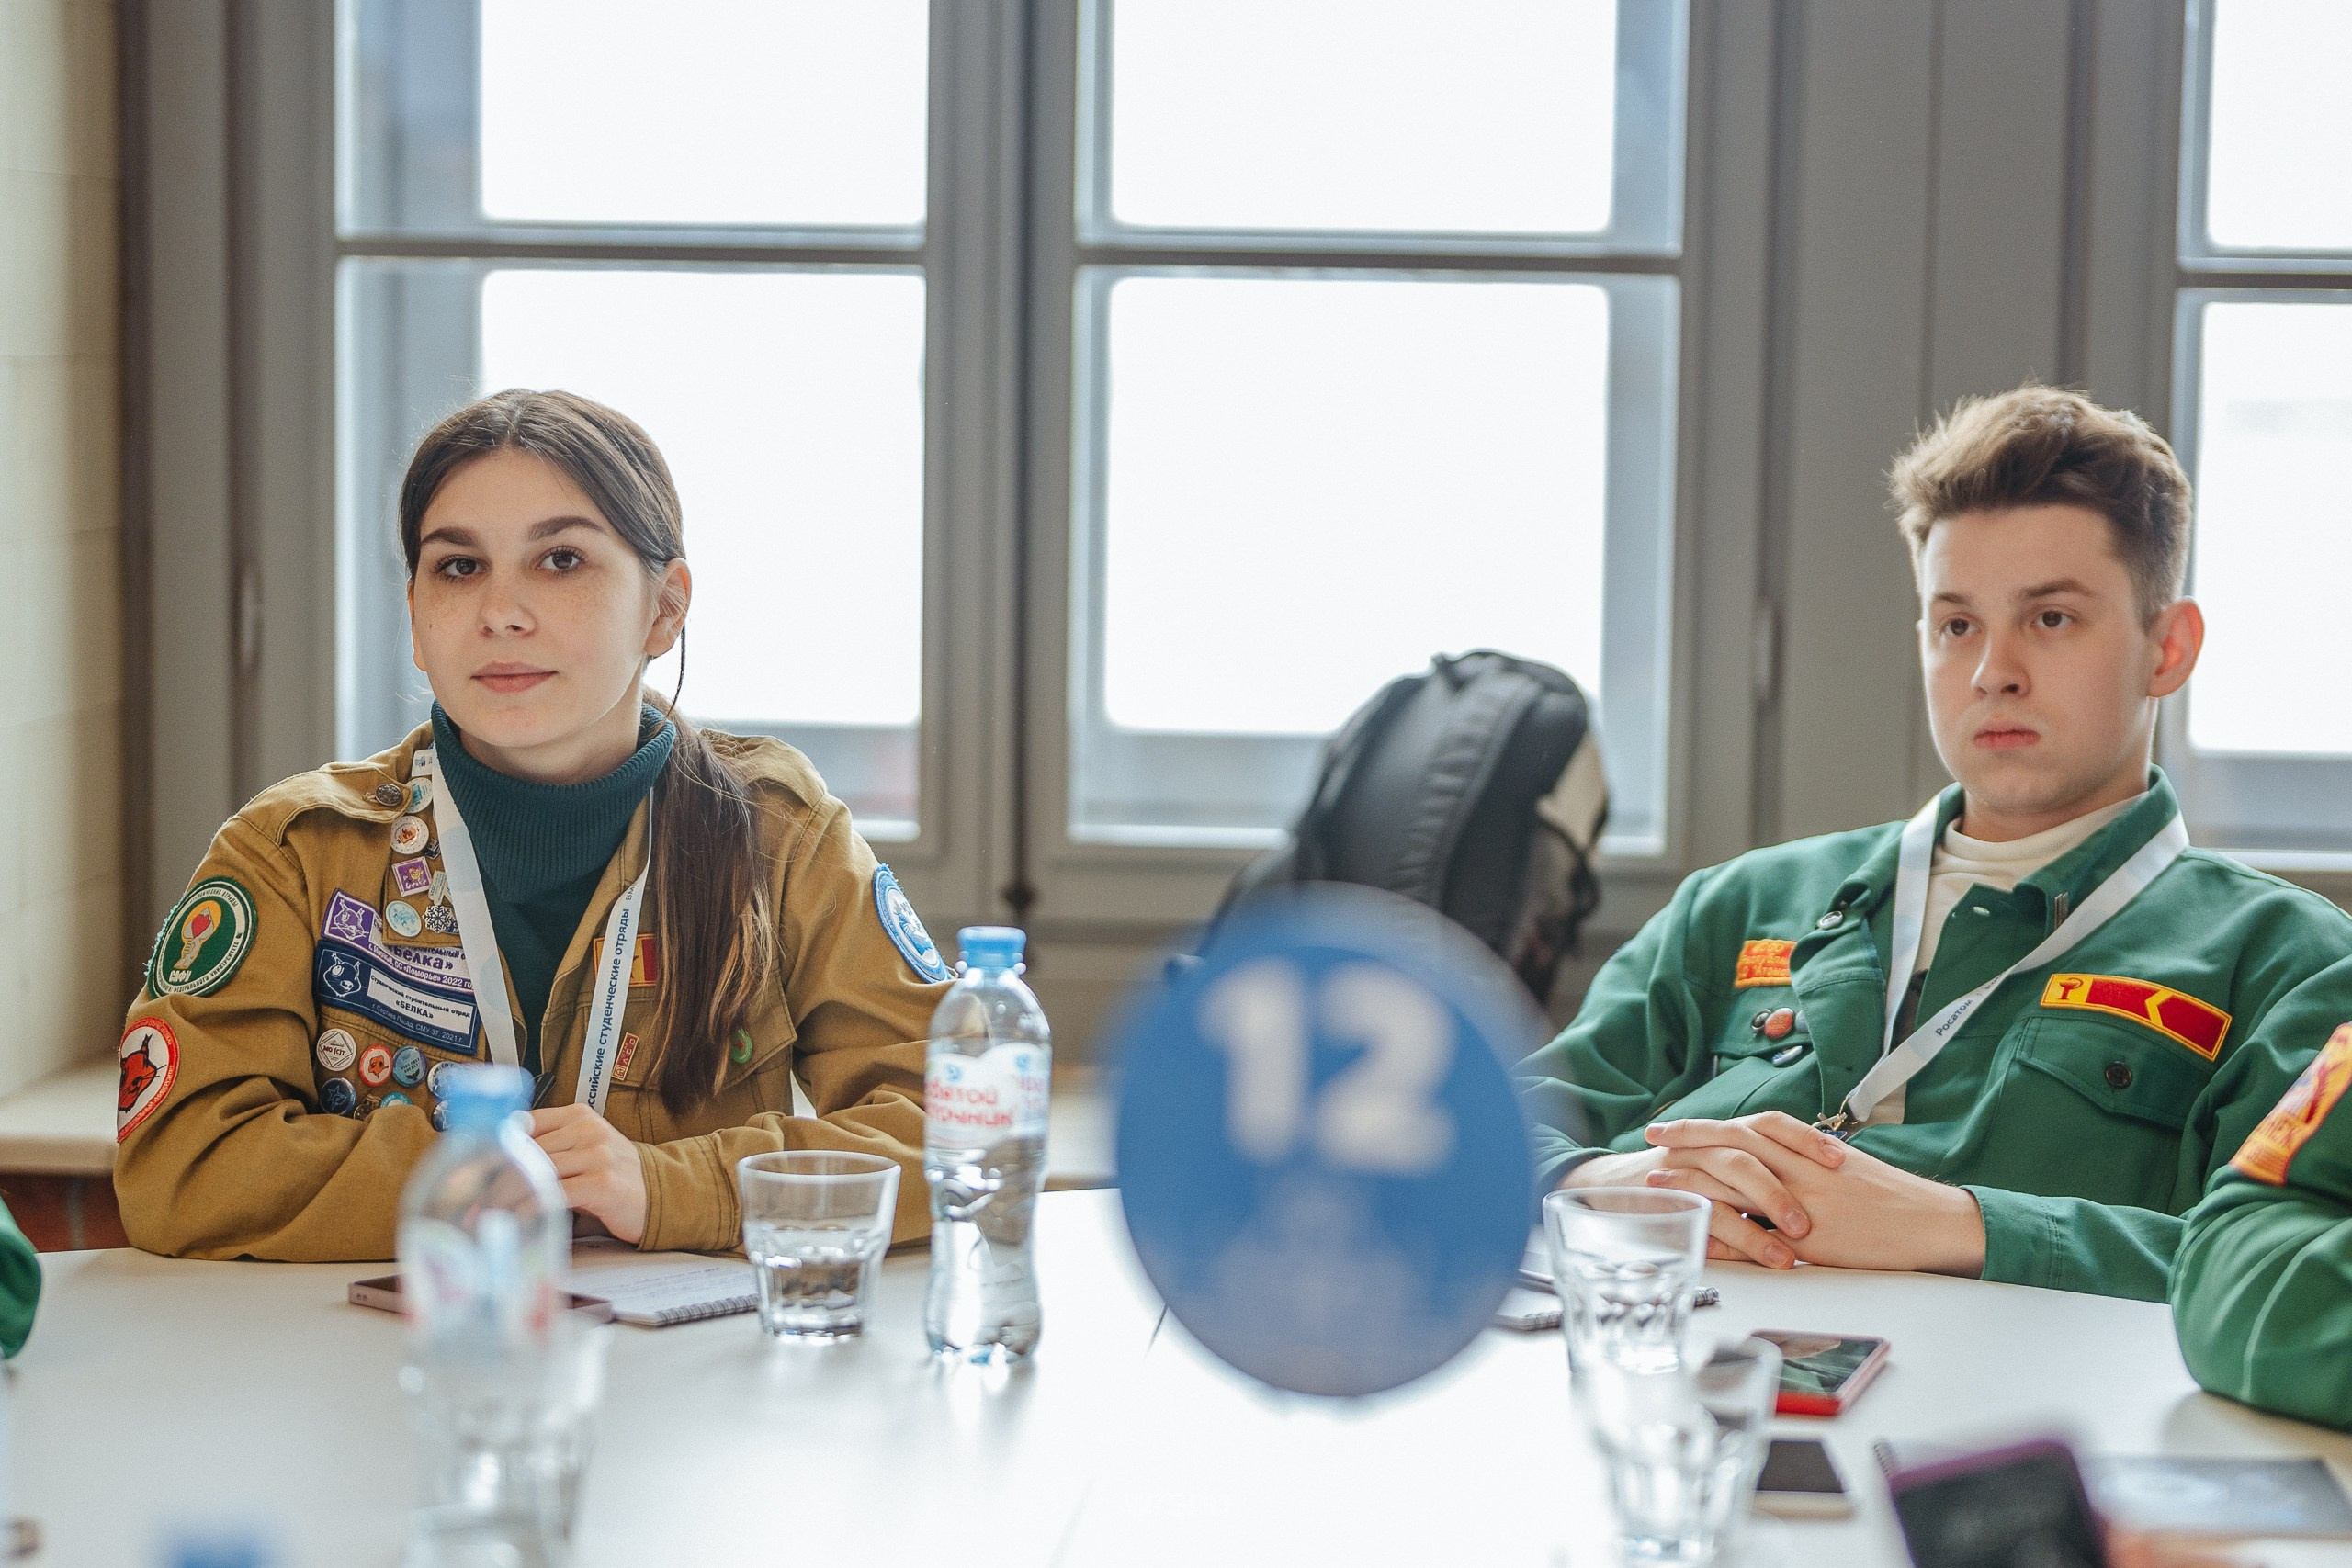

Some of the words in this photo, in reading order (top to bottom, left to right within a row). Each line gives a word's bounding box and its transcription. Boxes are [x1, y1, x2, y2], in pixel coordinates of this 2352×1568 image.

[404, 964, 441, 982] «Поморье»
[441, 975, 463, 987] 2022
[599, 958, 621, 1045] студенческие
[615, 908, 629, 955] отряды
[395, 998, 434, 1019] «БЕЛКА»
[405, 994, 450, 1012] строительный
[450, 1008, 470, 1019] отряд
[1935, 998, 1973, 1037] Росатом
[441, 1032, 458, 1041] 2021
[1204, 960, 1459, 1174] 12
